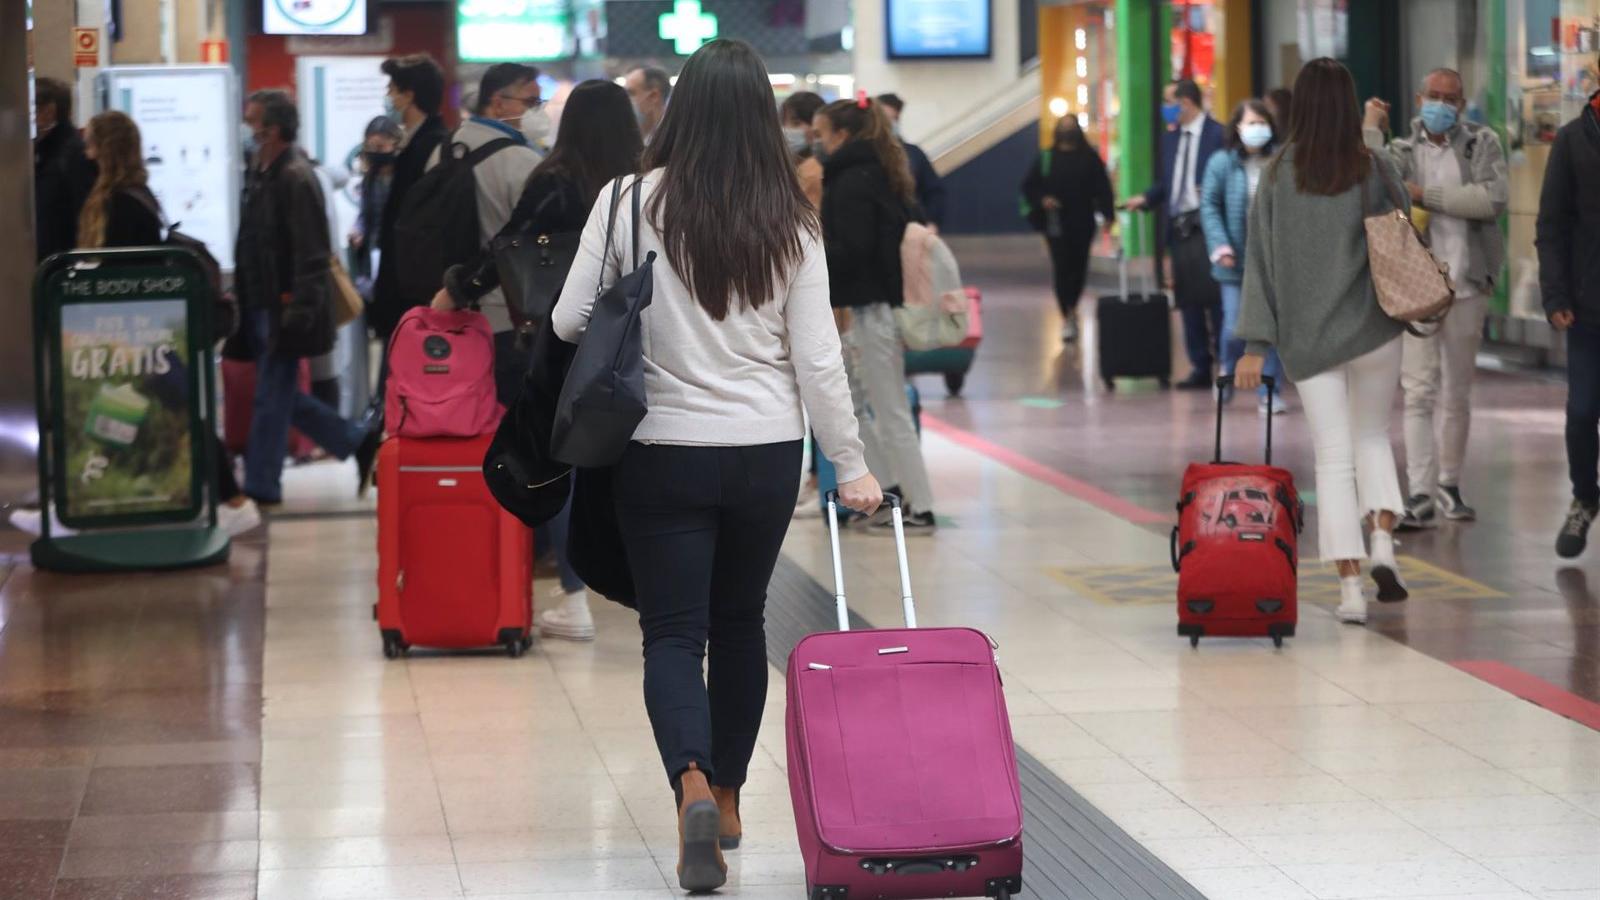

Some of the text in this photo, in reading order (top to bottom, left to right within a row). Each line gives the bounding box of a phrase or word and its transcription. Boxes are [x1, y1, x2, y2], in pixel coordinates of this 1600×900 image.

[62, 277, 185, 295] THE BODY SHOP
[71, 343, 172, 380] GRATIS
